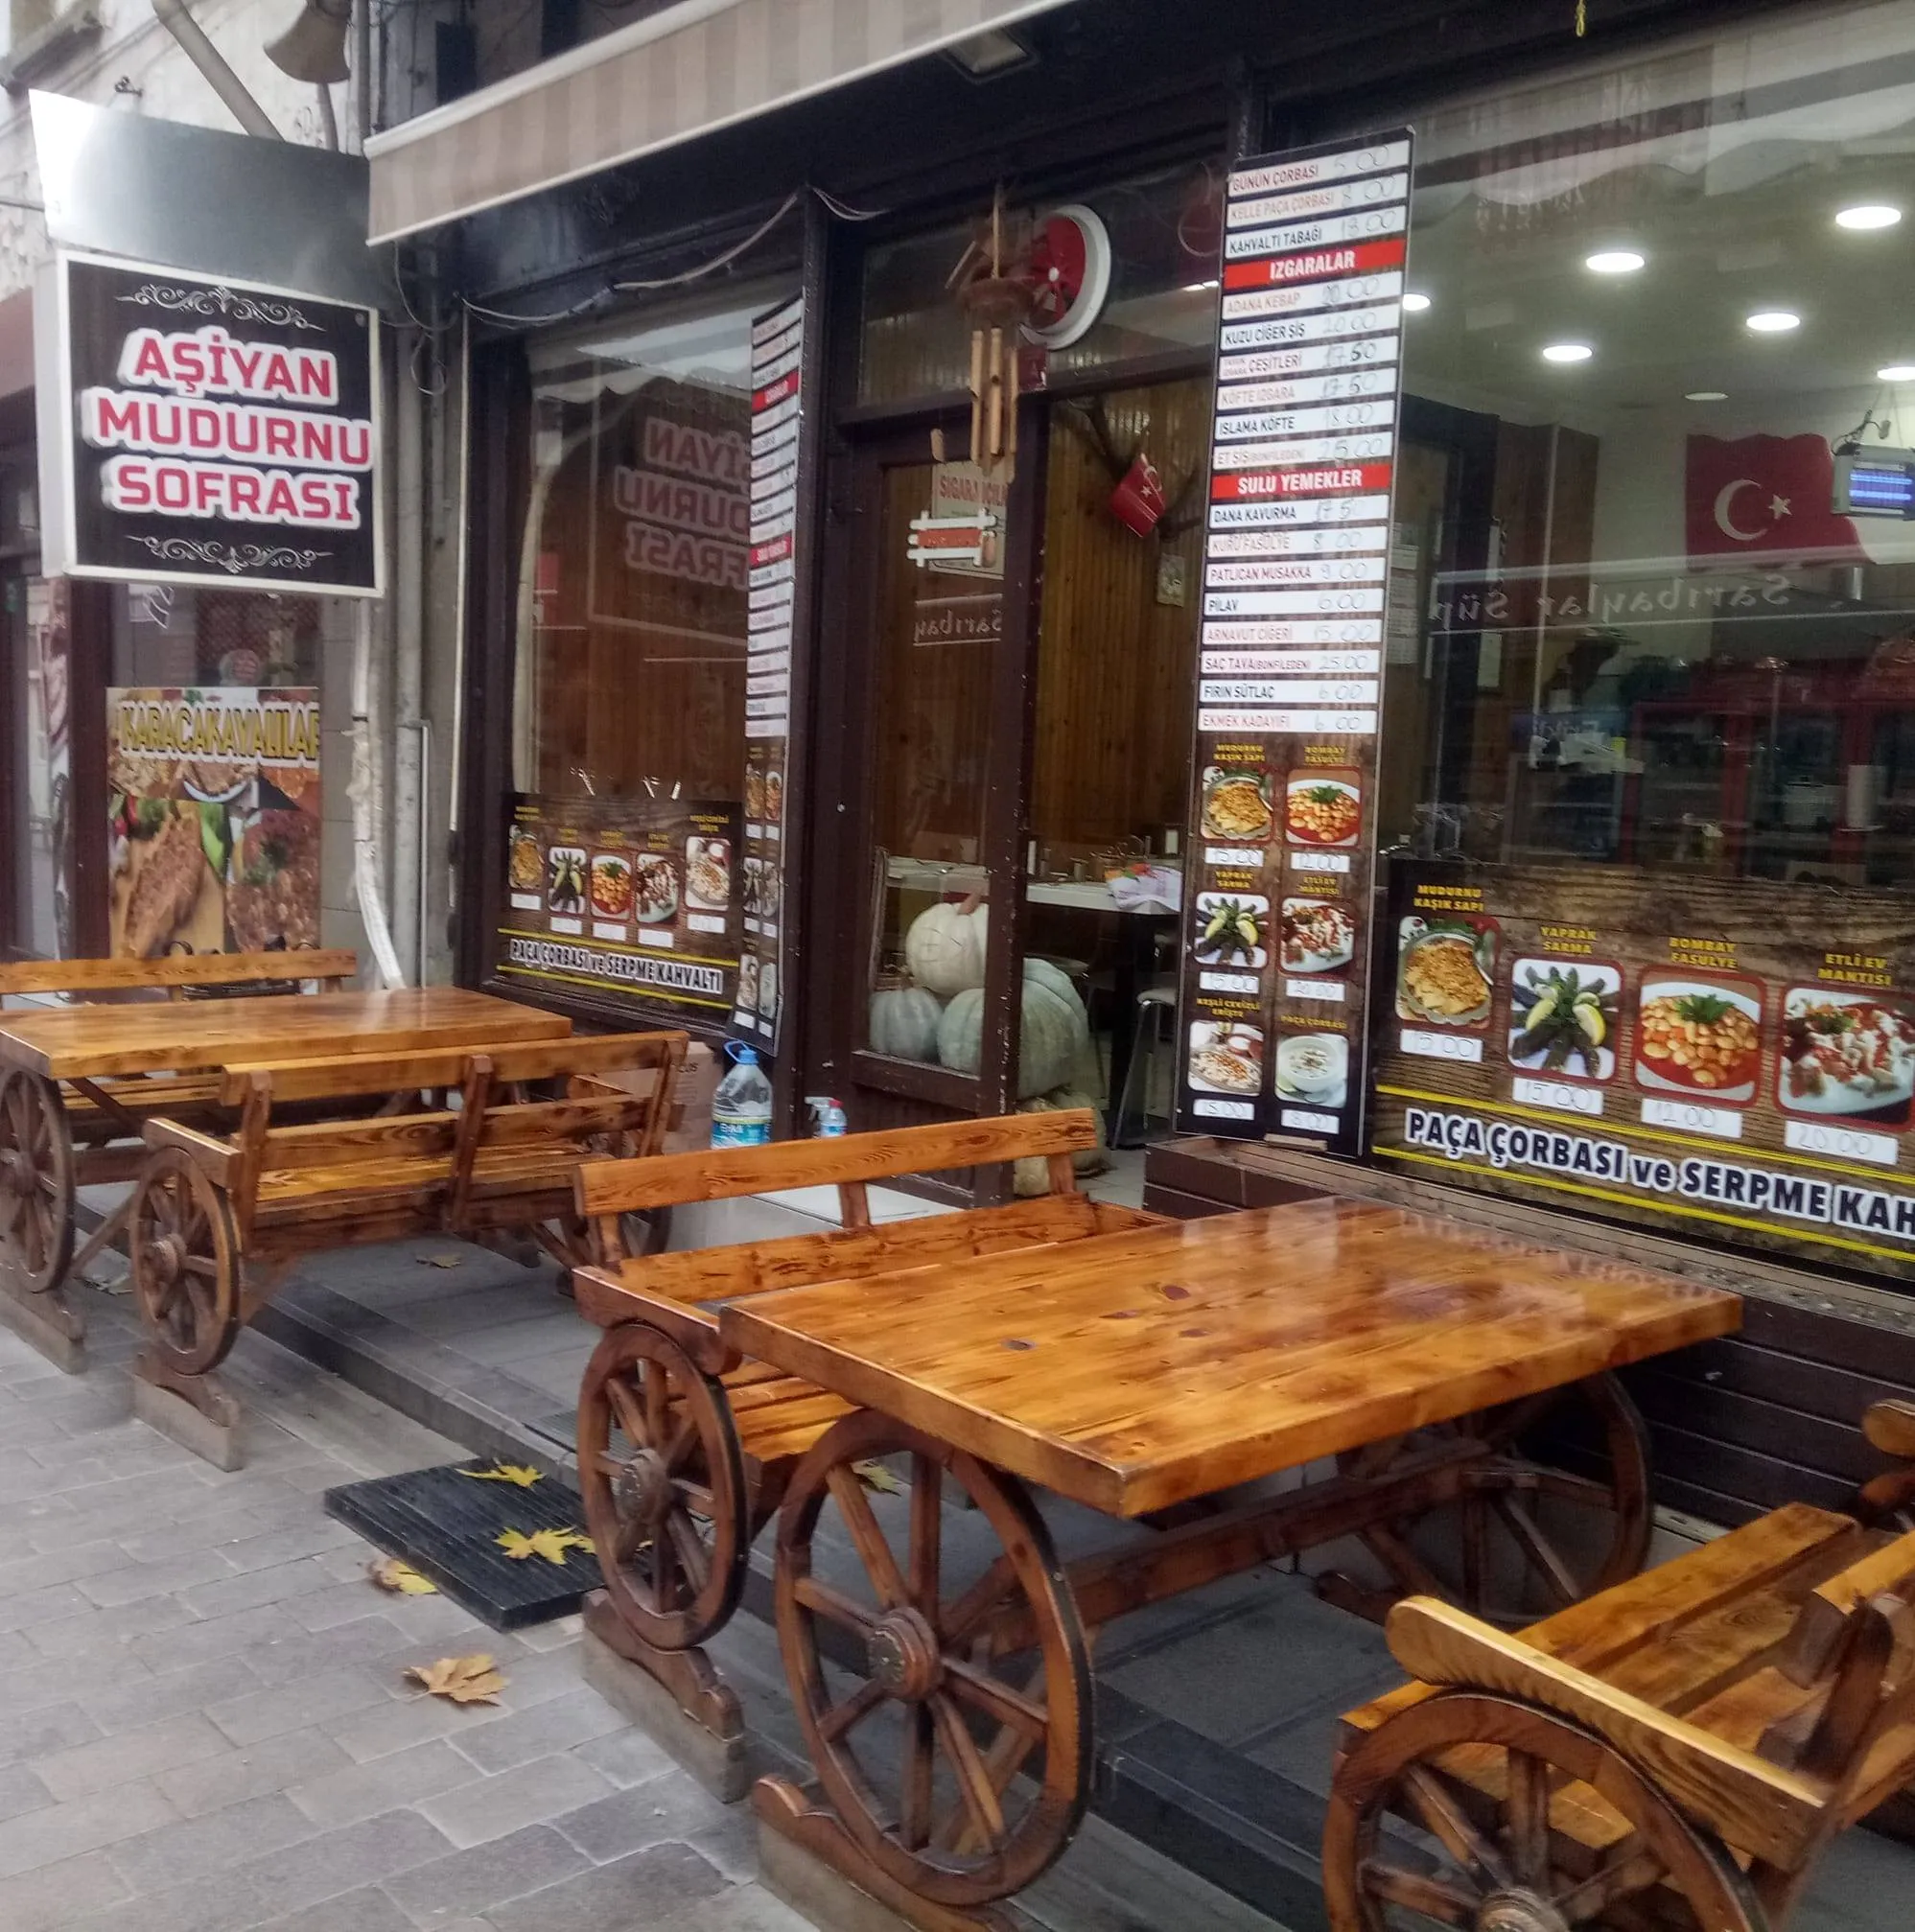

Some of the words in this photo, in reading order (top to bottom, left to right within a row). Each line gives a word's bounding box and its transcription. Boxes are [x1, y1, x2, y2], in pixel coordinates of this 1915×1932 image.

[1229, 234, 1280, 254] KAHVALTI
[1270, 250, 1355, 279] IZGARALAR
[133, 333, 332, 398] AŞİYAN
[98, 397, 369, 465] MUDURNU
[1259, 414, 1295, 431] KÖFTE
[1238, 475, 1275, 495] SULU
[1280, 469, 1362, 493] YEMEKLER
[117, 464, 354, 522] SOFRASI
[1417, 884, 1482, 898] MUDURNU
[1413, 897, 1451, 911] KAŞIK
[1454, 901, 1484, 913] SAPI
[1540, 926, 1597, 941] YAPRAK
[1542, 941, 1593, 955] SARMA
[1669, 936, 1736, 954] BOMBAY
[1671, 951, 1739, 969] FASULYE
[1825, 953, 1860, 967] ETLİ
[1863, 956, 1887, 969] EV
[606, 955, 655, 981] SERPME
[657, 962, 722, 993] KAHVALTI
[1817, 967, 1891, 986] MANTISI
[1407, 1110, 1483, 1155] PAÇA
[1490, 1124, 1627, 1179] ÇORBASI
[1633, 1159, 1672, 1187] ve
[1683, 1161, 1827, 1218] SERPME
